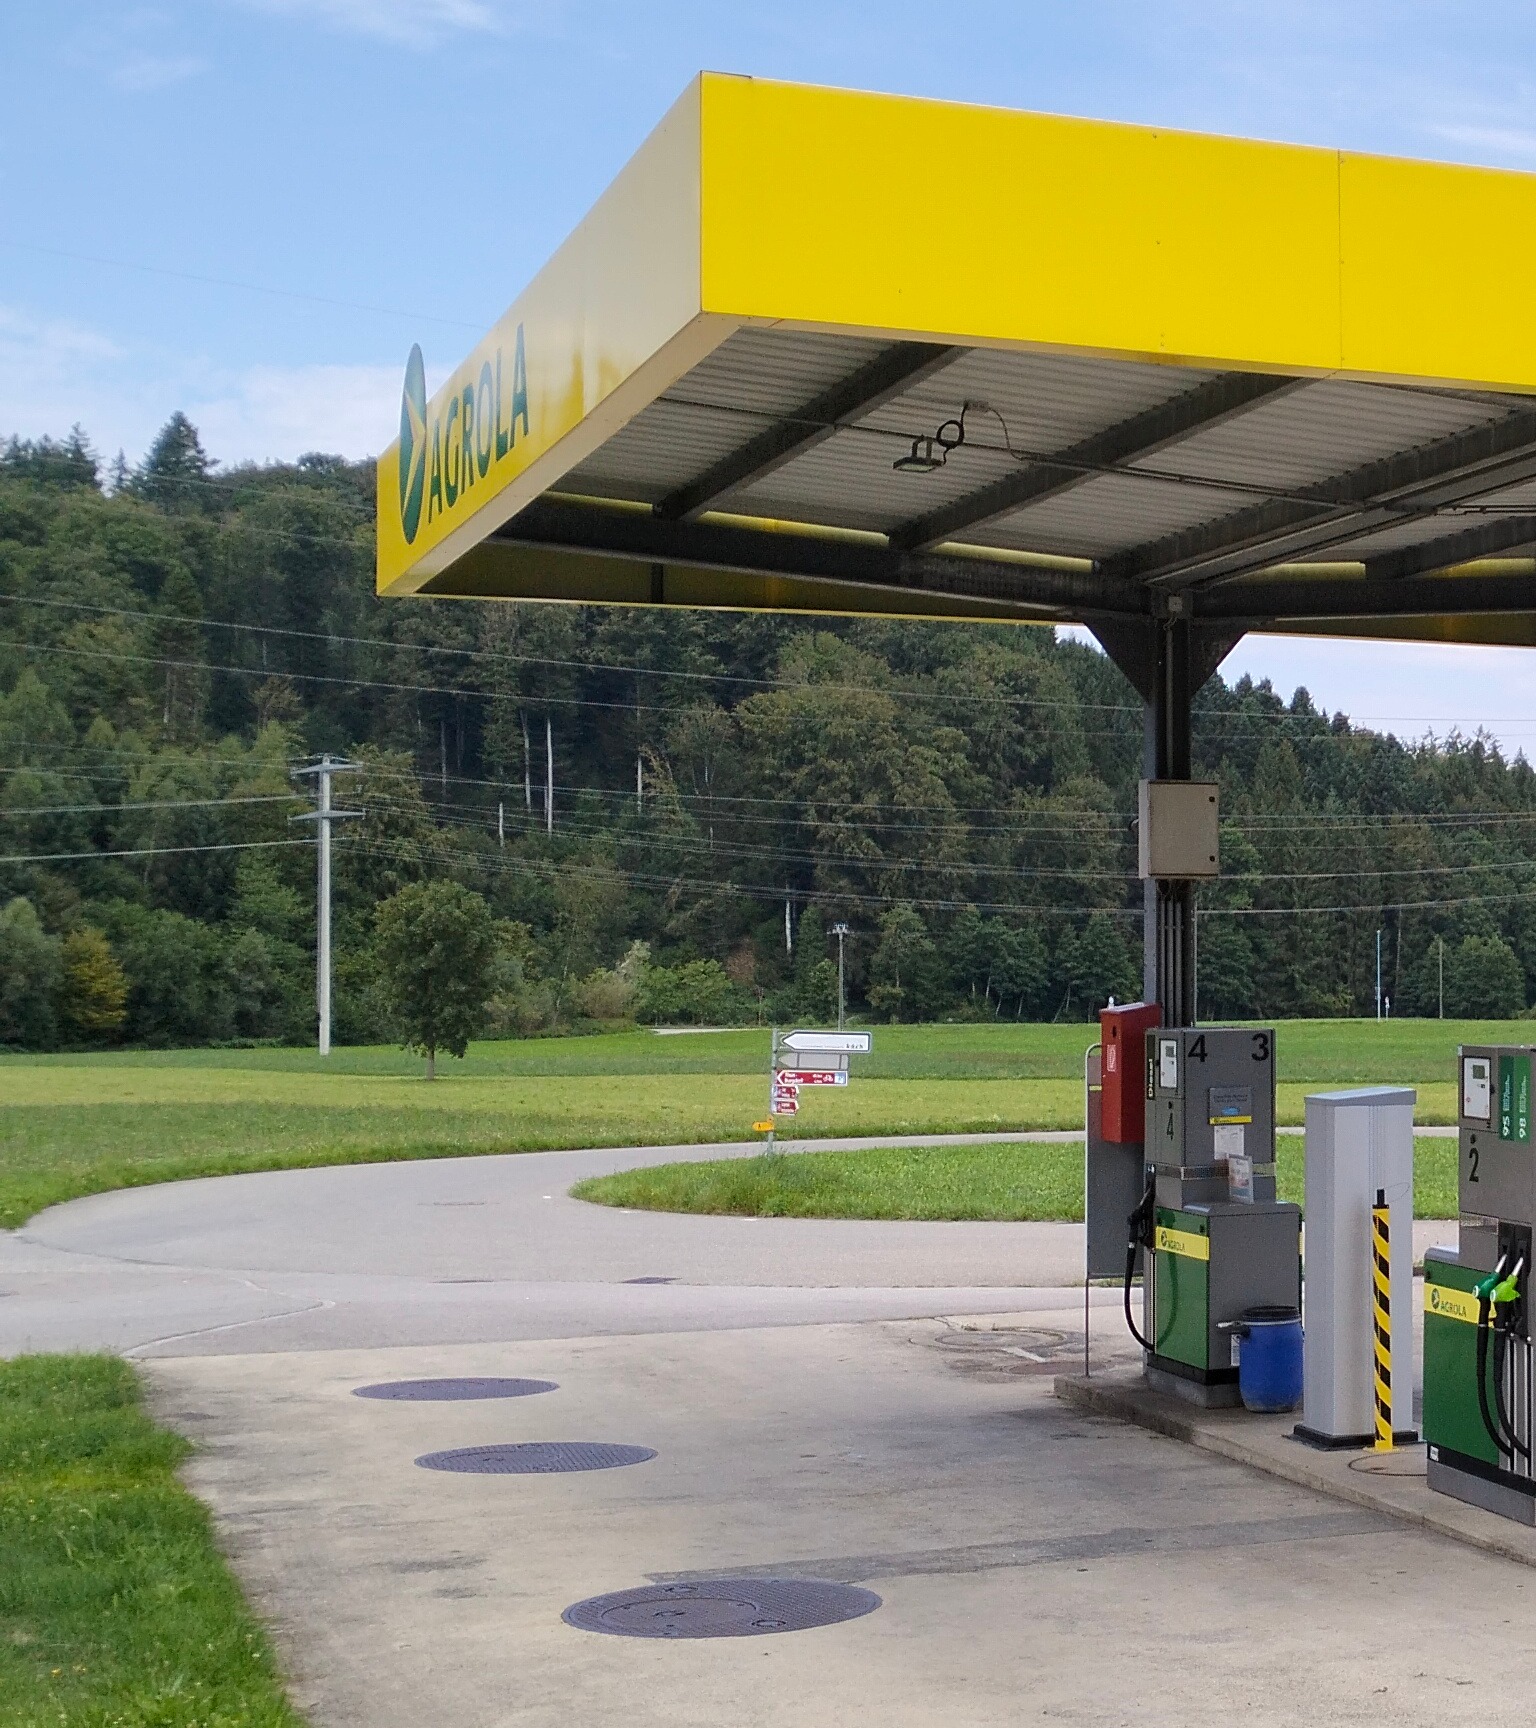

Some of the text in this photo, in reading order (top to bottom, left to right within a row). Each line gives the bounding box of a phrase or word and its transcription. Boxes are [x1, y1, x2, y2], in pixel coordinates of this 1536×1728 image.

[428, 322, 530, 525] AGROLA
[1188, 1034, 1208, 1063] 4
[1251, 1033, 1270, 1062] 3
[1166, 1113, 1174, 1141] 4
[1502, 1116, 1511, 1136] 95
[1519, 1117, 1527, 1138] 98
[1468, 1147, 1479, 1182] 2
[1440, 1300, 1467, 1318] AGROLA
